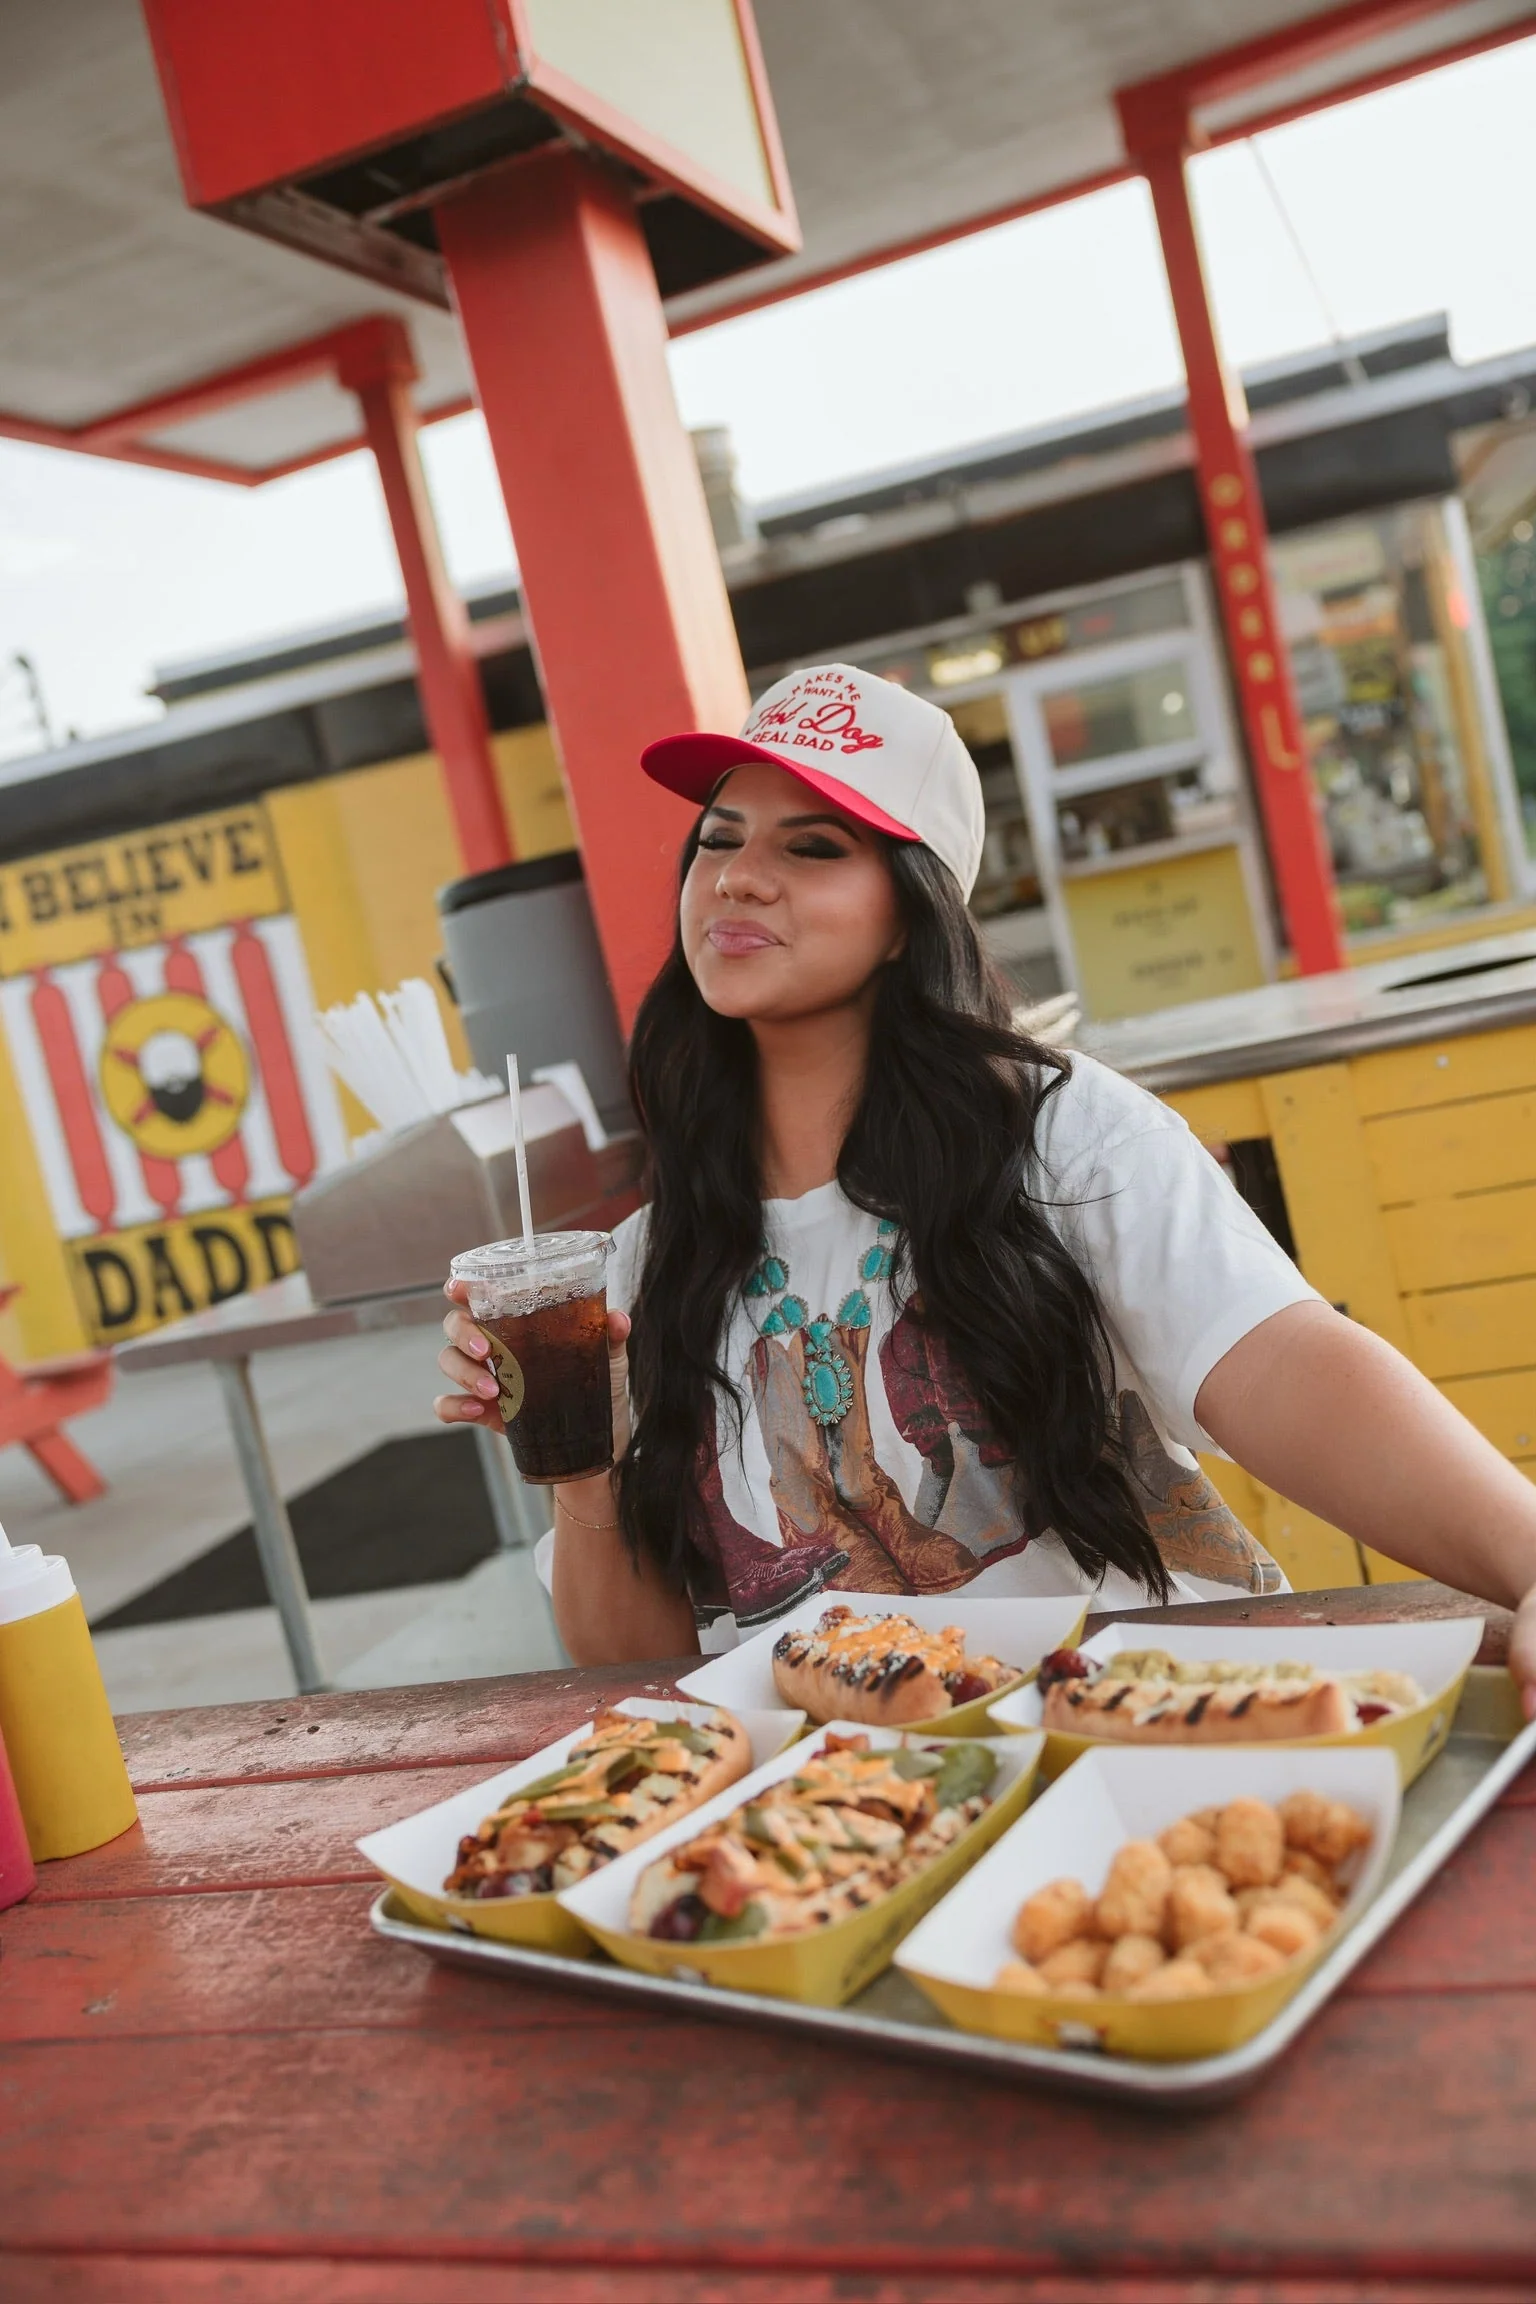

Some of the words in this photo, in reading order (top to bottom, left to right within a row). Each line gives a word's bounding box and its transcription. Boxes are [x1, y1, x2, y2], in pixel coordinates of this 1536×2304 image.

[803, 687, 838, 699] WANT
[834, 692, 844, 701] A
[844, 682, 861, 702] ME
[745, 697, 808, 735] Hot
[797, 702, 884, 754] Dog
[750, 730, 789, 744] REAL
[792, 733, 834, 751] BAD
[22, 818, 263, 924] BELIEVE
[84, 1213, 302, 1329] DADD
